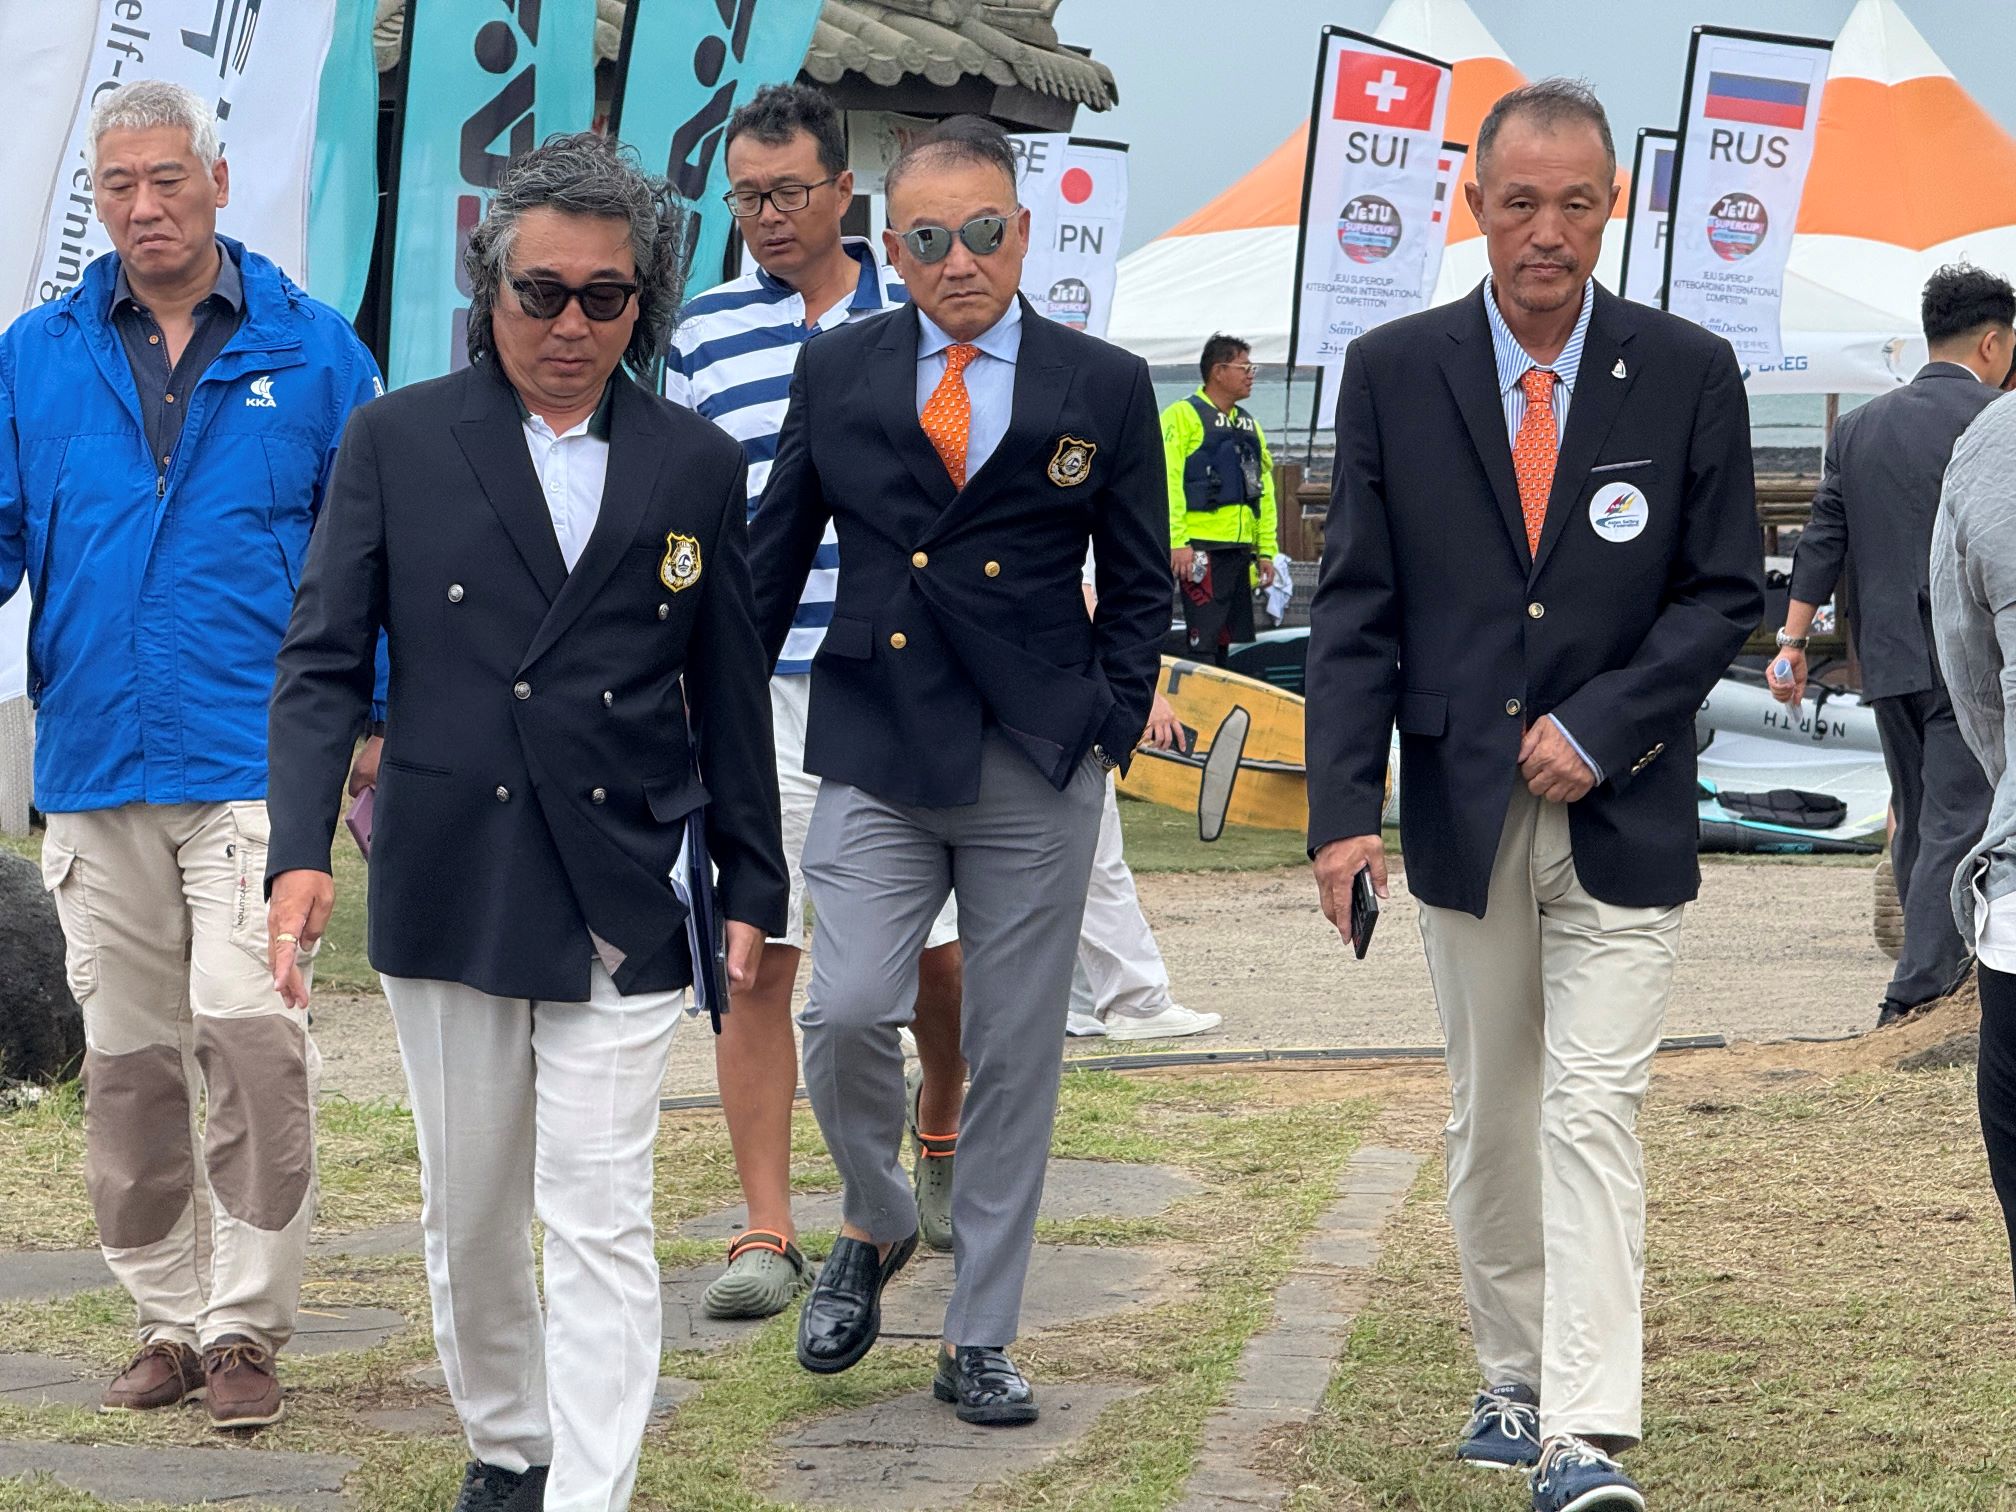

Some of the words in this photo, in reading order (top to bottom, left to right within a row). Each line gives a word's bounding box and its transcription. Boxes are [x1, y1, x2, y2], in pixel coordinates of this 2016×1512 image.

[1346, 131, 1409, 169] SUI
[1710, 128, 1789, 168] RUS
[1348, 200, 1392, 223] JEJU
[1718, 198, 1760, 220] JEJU
[1053, 224, 1103, 254] PN
[1051, 283, 1086, 301] JEJU
[246, 398, 276, 407] KKA
[1764, 709, 1845, 738] NORTH
[1494, 1386, 1514, 1394] crocs
